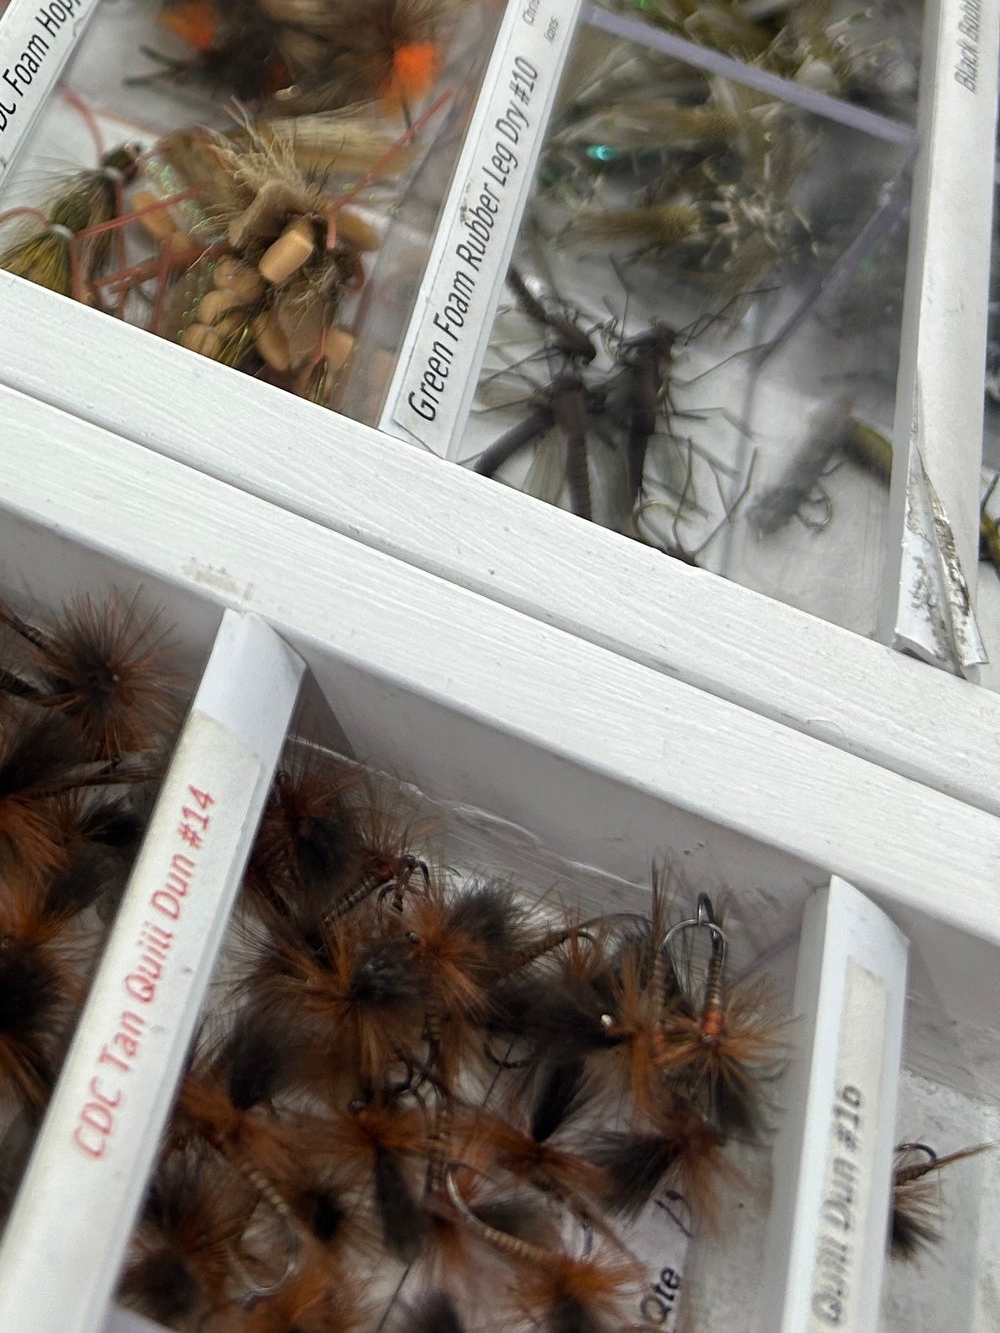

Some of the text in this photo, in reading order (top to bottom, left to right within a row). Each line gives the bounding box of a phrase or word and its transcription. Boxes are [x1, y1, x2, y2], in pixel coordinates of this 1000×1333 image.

[1, 33, 50, 97] Foam
[407, 55, 539, 422] Green Foam Rubber Leg Dry #10
[71, 784, 216, 1162] CDC Tan Quill Dun #14
[640, 1266, 681, 1324] Qte
